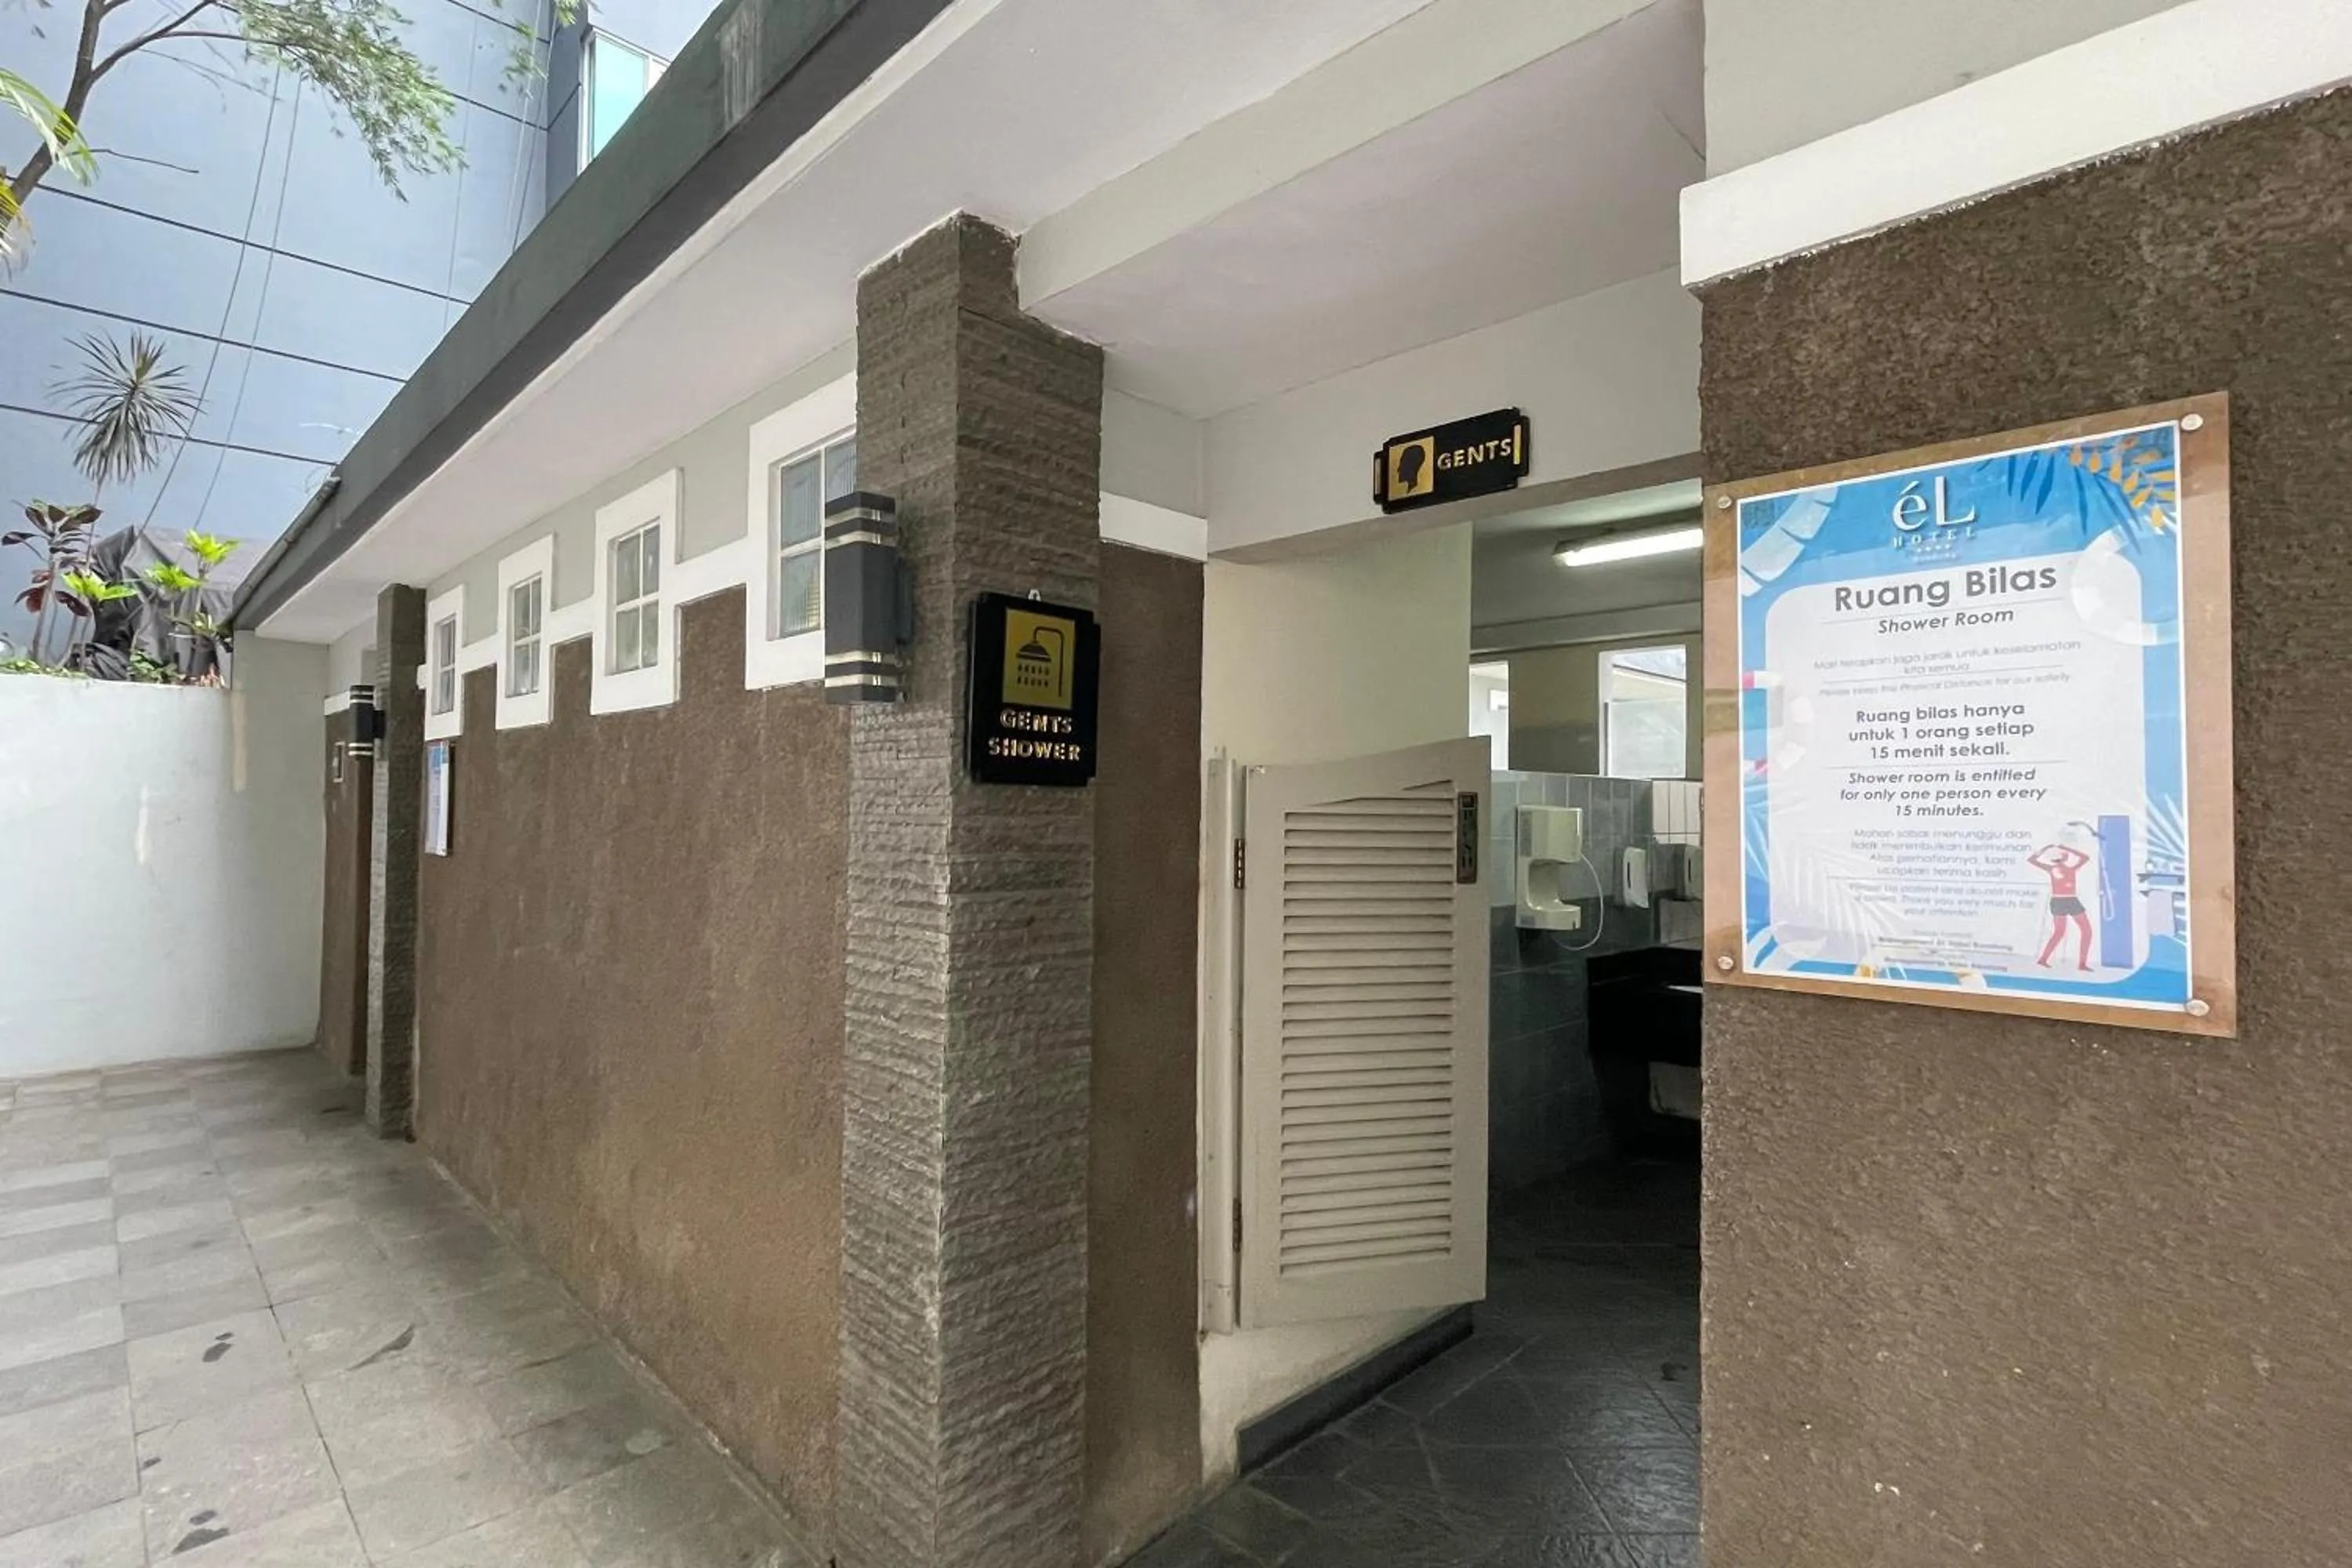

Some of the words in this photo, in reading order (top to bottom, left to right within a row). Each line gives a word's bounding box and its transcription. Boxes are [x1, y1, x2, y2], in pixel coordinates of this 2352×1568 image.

[1437, 438, 1512, 470] GENTS
[1892, 476, 1976, 531] éL
[1893, 526, 1976, 549] HOTEL
[1835, 579, 1950, 612] Ruang
[1965, 566, 2057, 597] Bilas
[1878, 615, 1949, 634] Shower
[1955, 609, 2014, 626] Room
[1000, 708, 1073, 733] GENTS
[1856, 710, 1911, 724] Ruang
[1917, 706, 1958, 720] bilas
[1964, 704, 2025, 718] hanya
[1849, 728, 1895, 742] untuk
[1901, 728, 1908, 739] 1
[1915, 726, 1969, 739] orang
[1976, 721, 2034, 737] setiap
[988, 737, 1082, 761] SHOWER
[1871, 746, 1889, 759] 15
[1894, 744, 1944, 758] menit
[1950, 742, 2010, 757] sekali.
[1849, 771, 1904, 784] Shower
[1908, 772, 1950, 782] room
[1955, 769, 1965, 782] is
[1972, 768, 2036, 782] entitled
[1840, 789, 1860, 800] for
[1864, 789, 1896, 801] only
[1900, 791, 1930, 800] one
[1935, 789, 1991, 801] person
[1997, 787, 2047, 800] every
[1895, 805, 1912, 816] 15
[1917, 804, 1984, 816] minutes.
